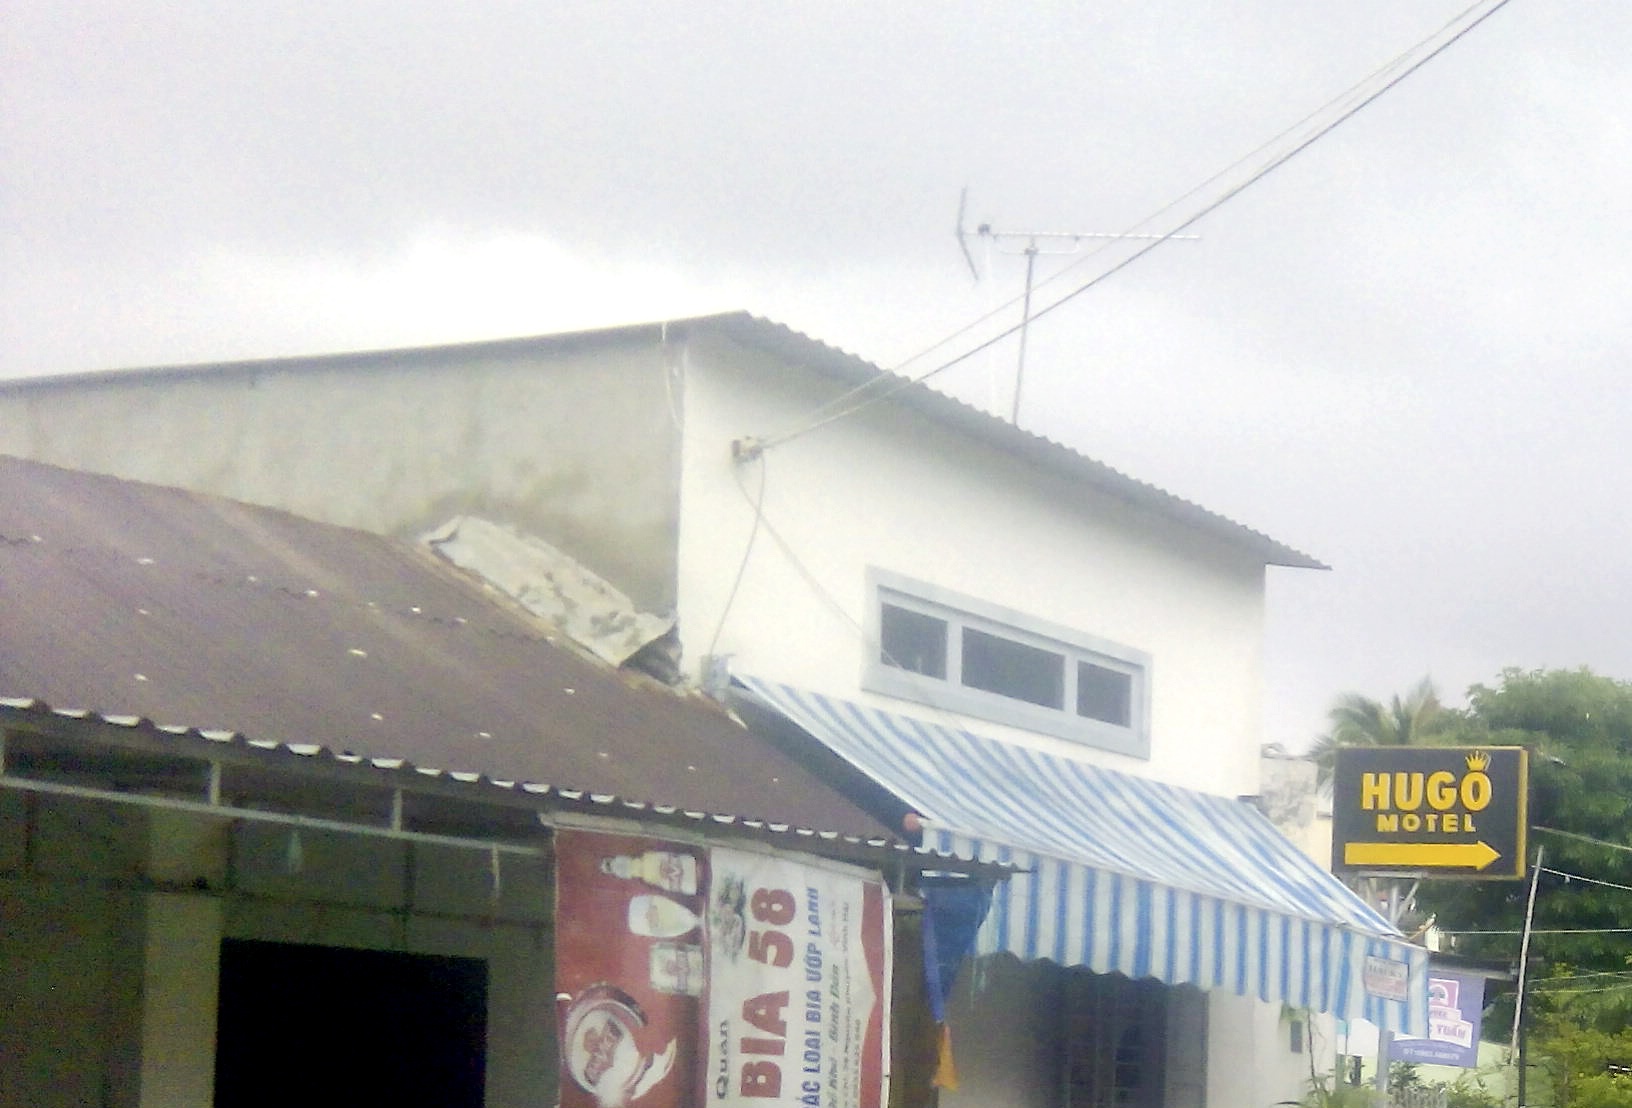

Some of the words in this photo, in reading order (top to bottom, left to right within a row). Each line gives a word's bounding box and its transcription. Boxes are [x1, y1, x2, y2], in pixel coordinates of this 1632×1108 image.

[1361, 771, 1493, 812] HUGO
[1376, 813, 1477, 833] MOTEL
[748, 887, 797, 969] 58
[806, 990, 822, 1023] BIA
[740, 990, 791, 1098] BIA
